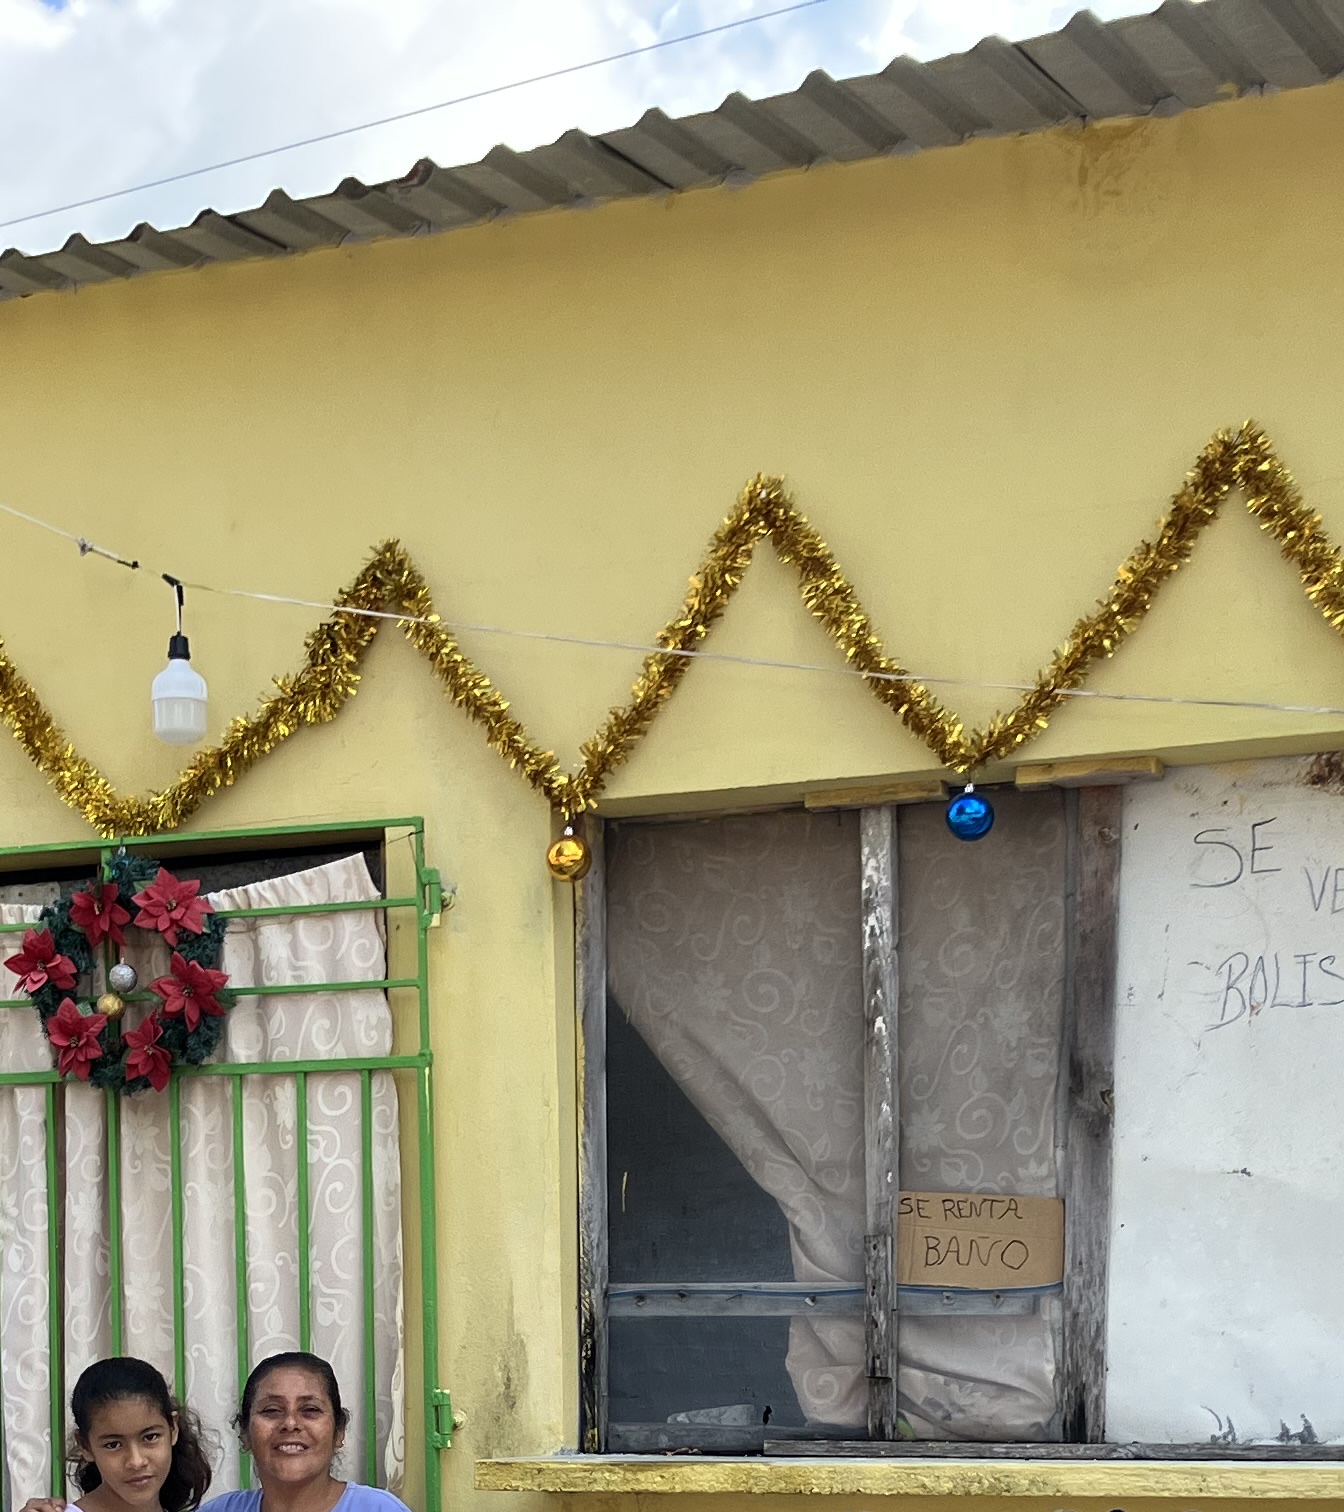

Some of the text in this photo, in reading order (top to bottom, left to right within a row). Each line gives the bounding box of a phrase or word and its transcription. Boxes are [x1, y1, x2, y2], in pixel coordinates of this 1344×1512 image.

[1190, 816, 1282, 888] SE
[898, 1197, 1023, 1221] SE RENTA
[923, 1235, 1030, 1270] BAÑO
